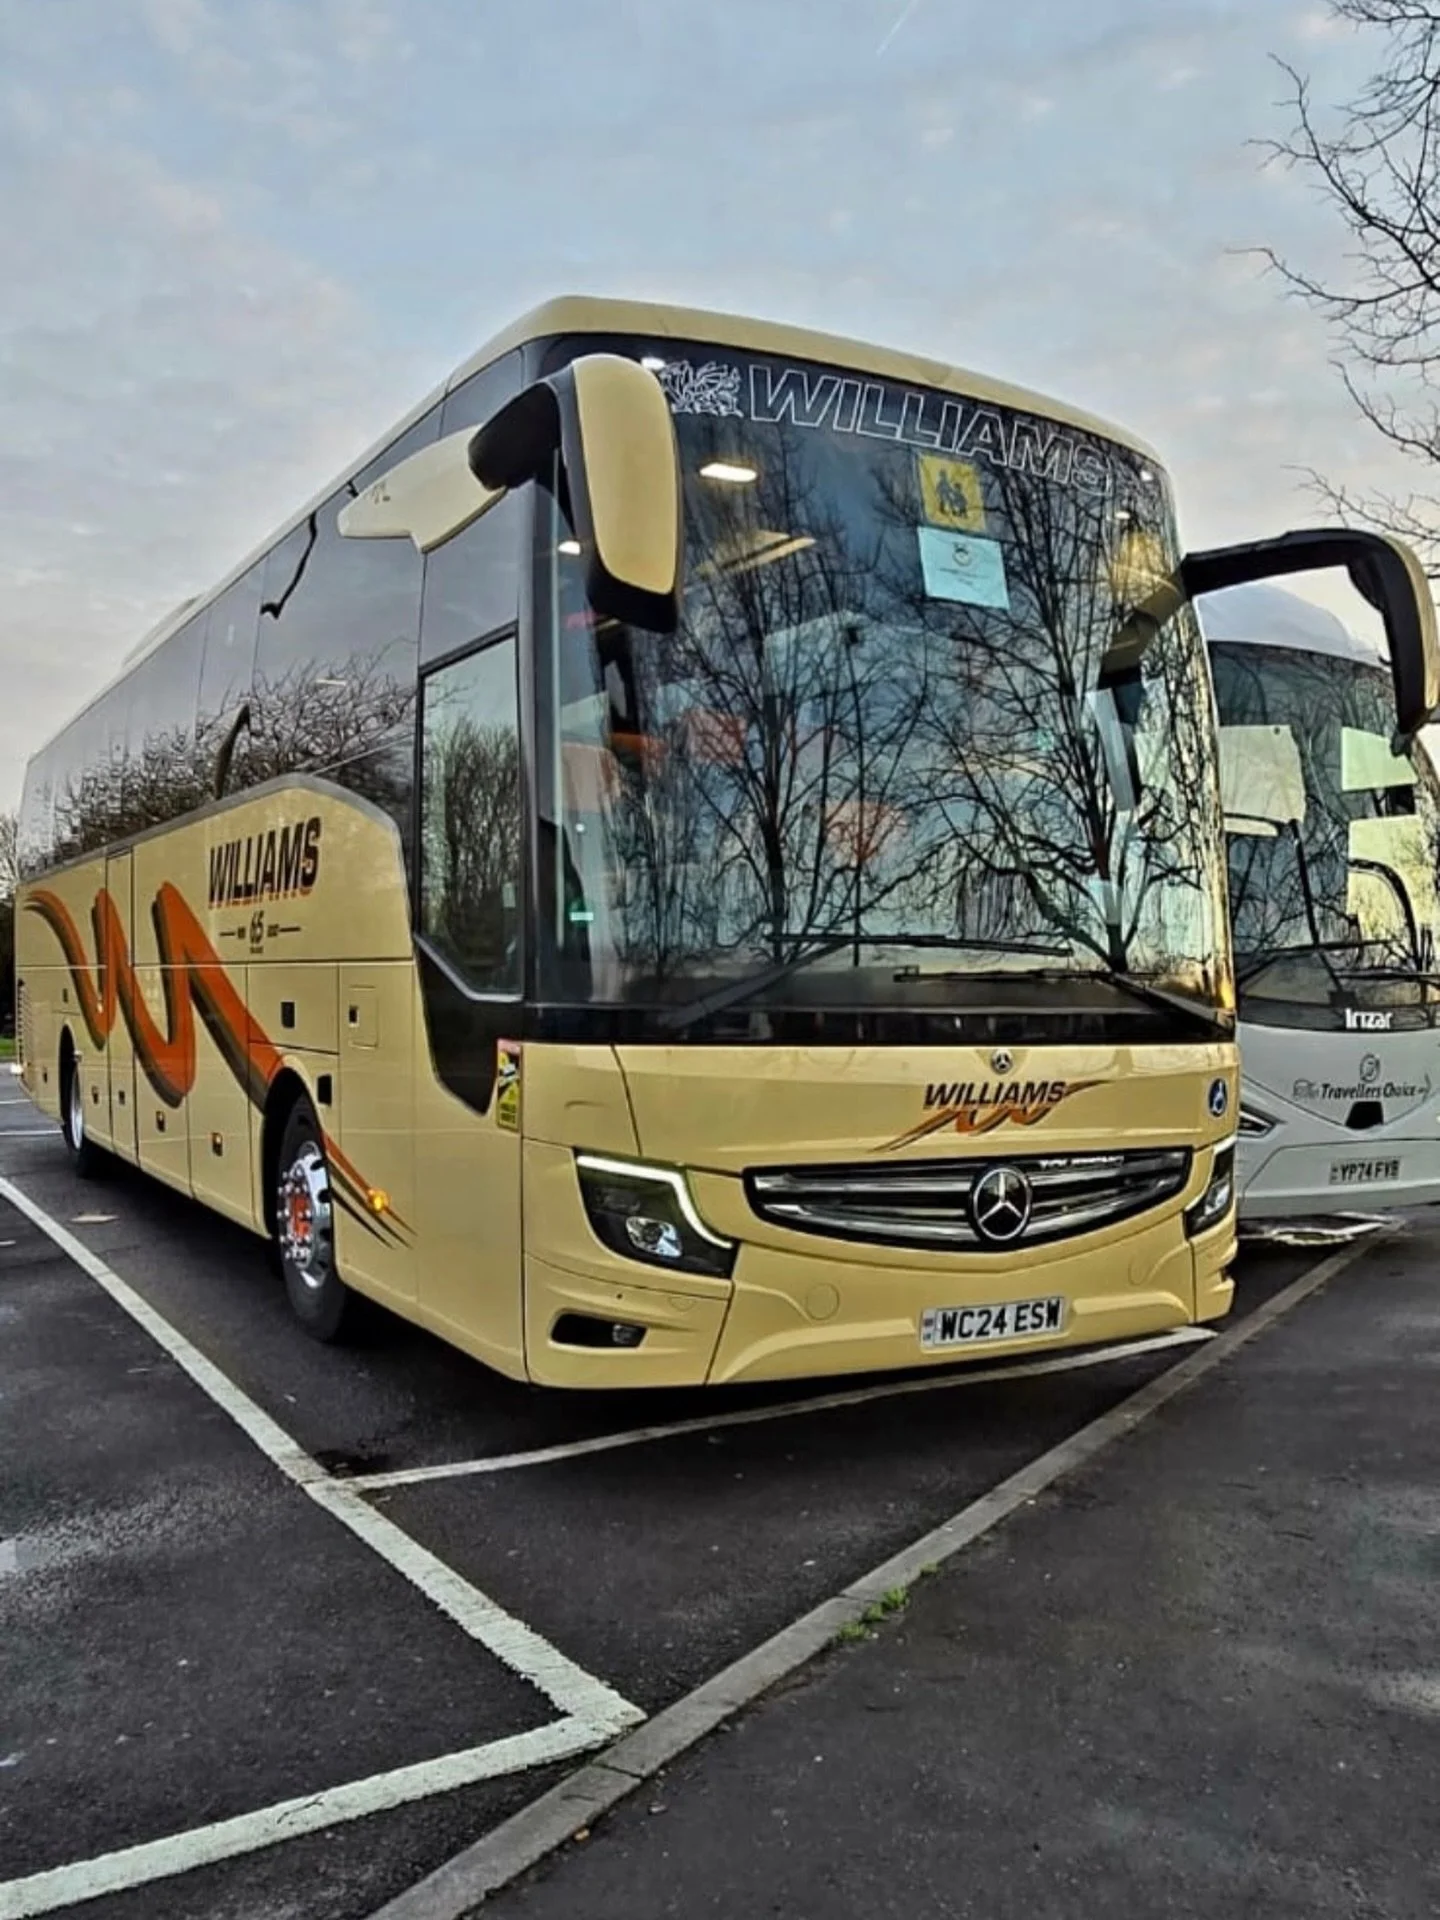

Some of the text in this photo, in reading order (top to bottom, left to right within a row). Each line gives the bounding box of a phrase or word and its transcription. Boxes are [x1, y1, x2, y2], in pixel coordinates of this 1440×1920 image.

[748, 364, 1113, 497] WILLIAMS
[208, 816, 321, 908] WILLIAMS
[923, 1080, 1066, 1107] WILLIAMS
[940, 1297, 1061, 1340] WC24 ESW
